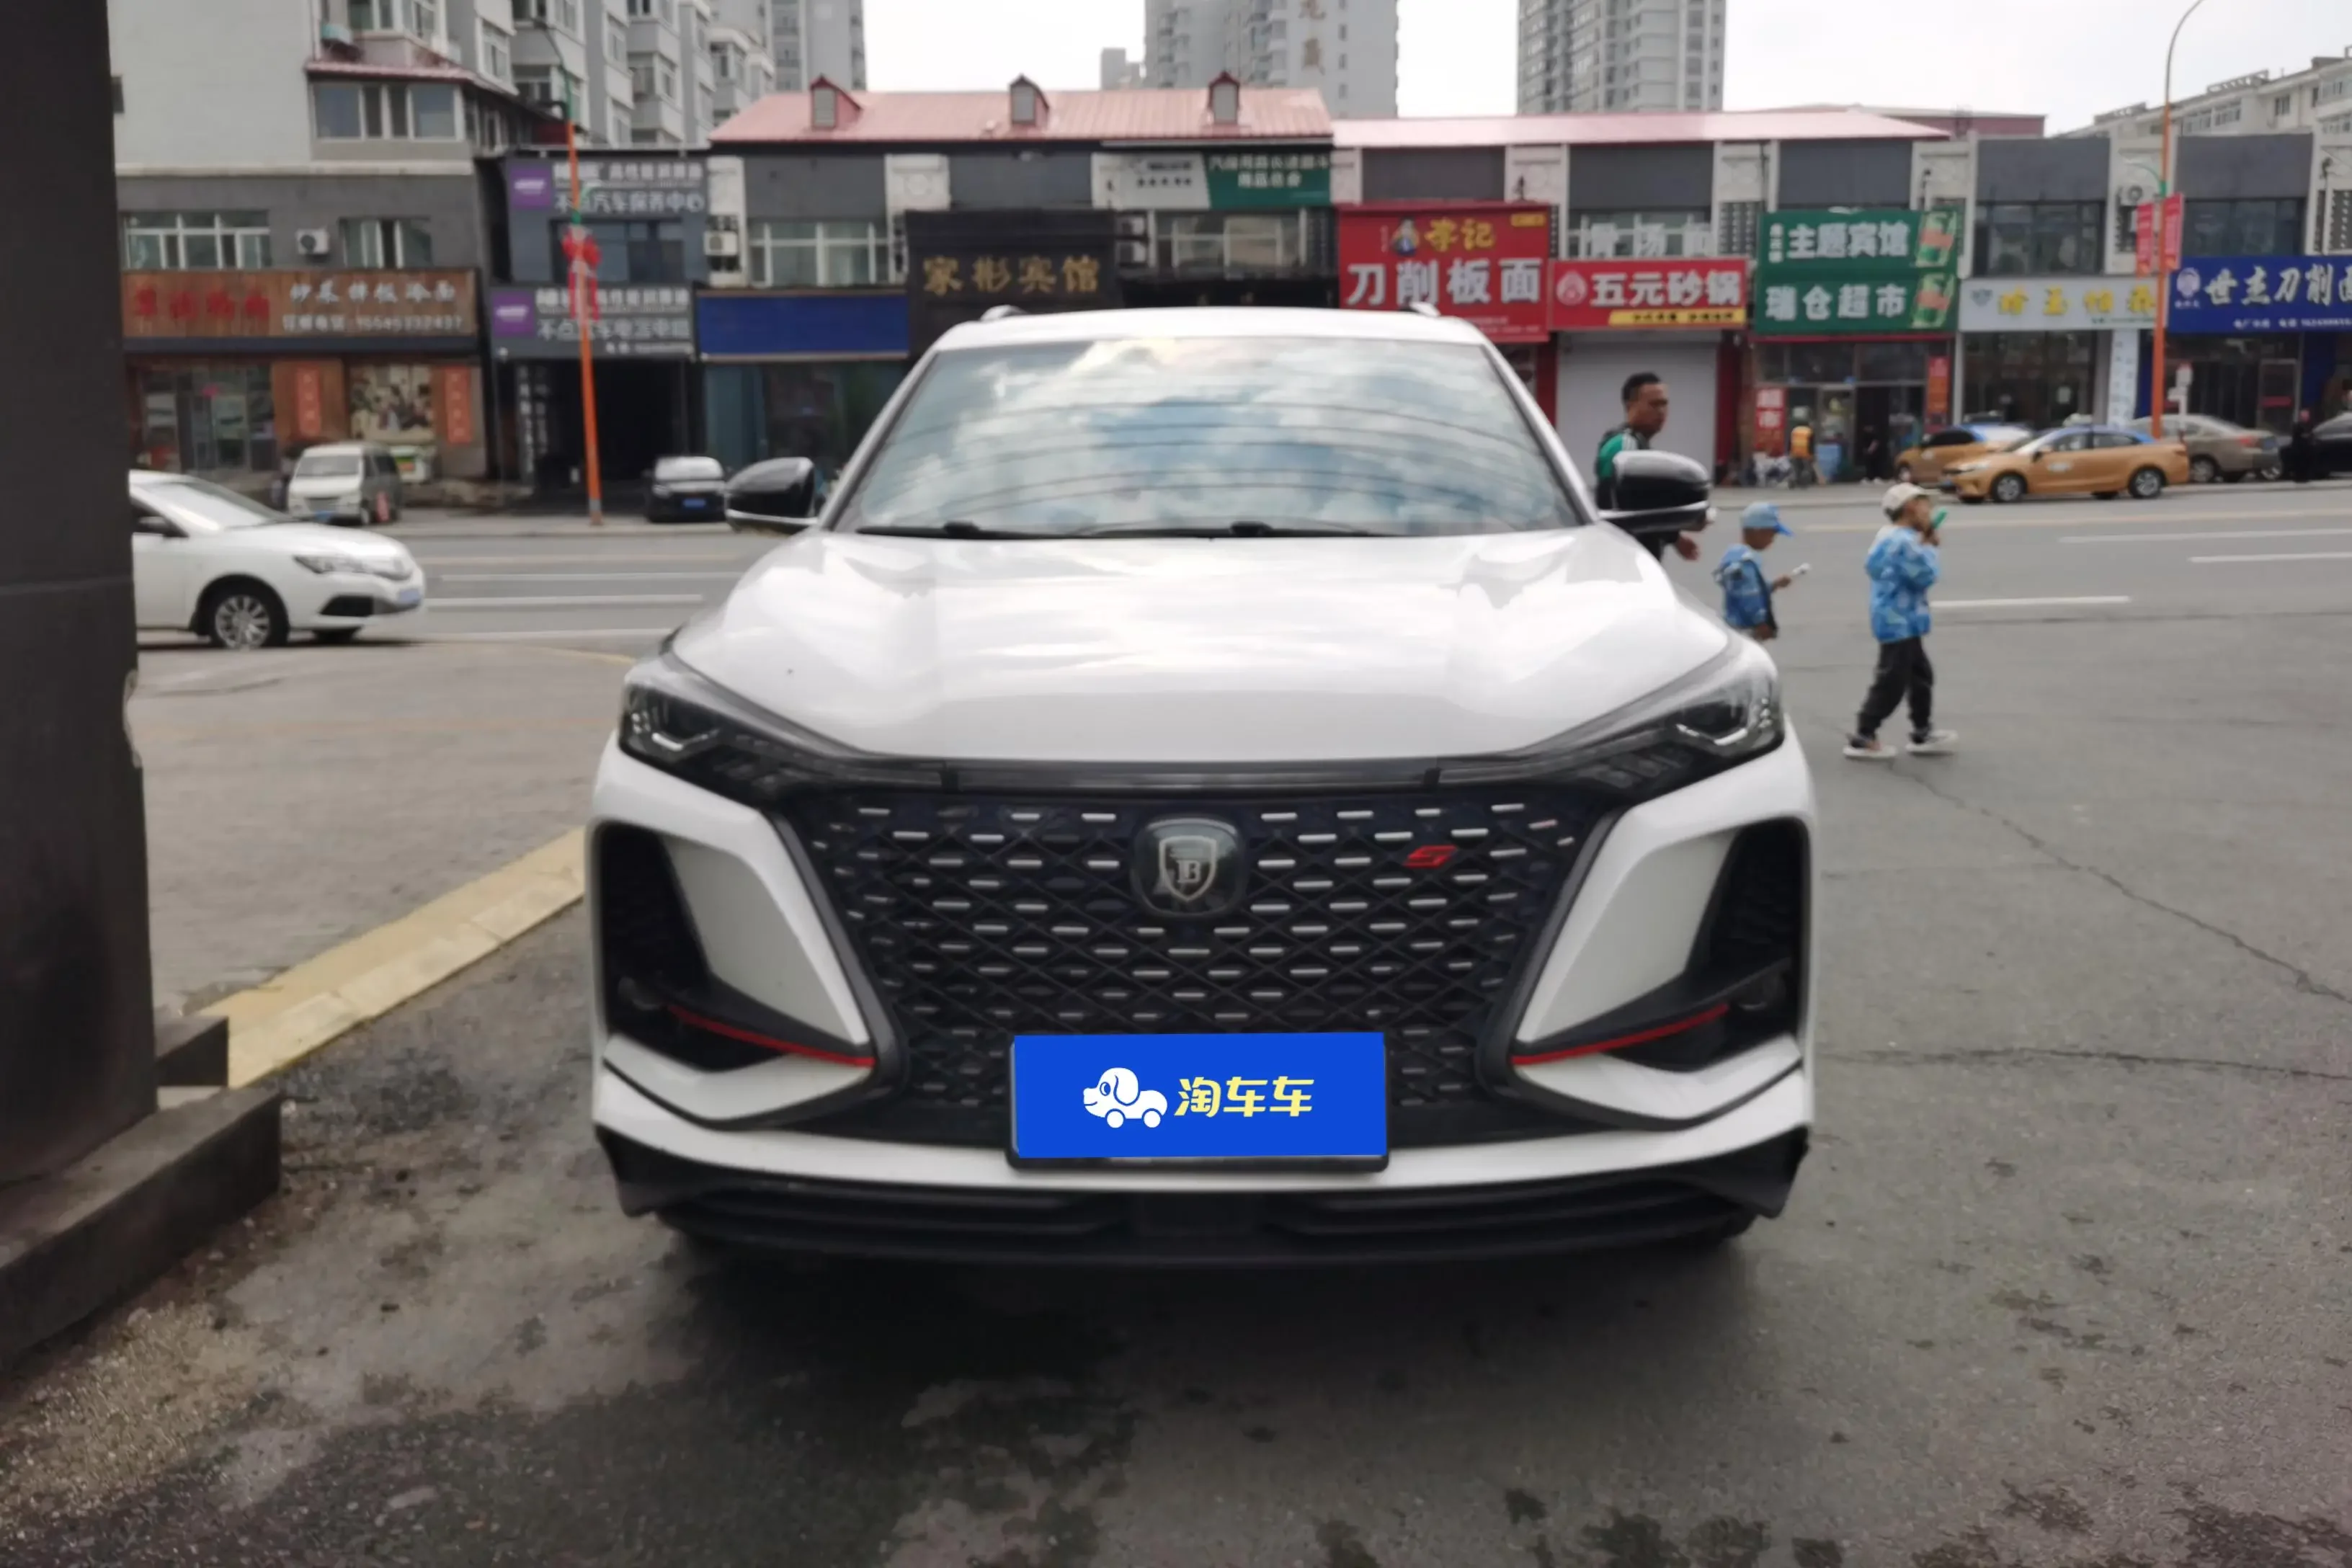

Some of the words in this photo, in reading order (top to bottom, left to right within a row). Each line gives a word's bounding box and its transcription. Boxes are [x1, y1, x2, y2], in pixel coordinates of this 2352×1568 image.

[1786, 220, 1910, 259] 主题宾馆
[1346, 257, 1544, 306] 刀削板面
[1590, 268, 1742, 308] 五元砂锅
